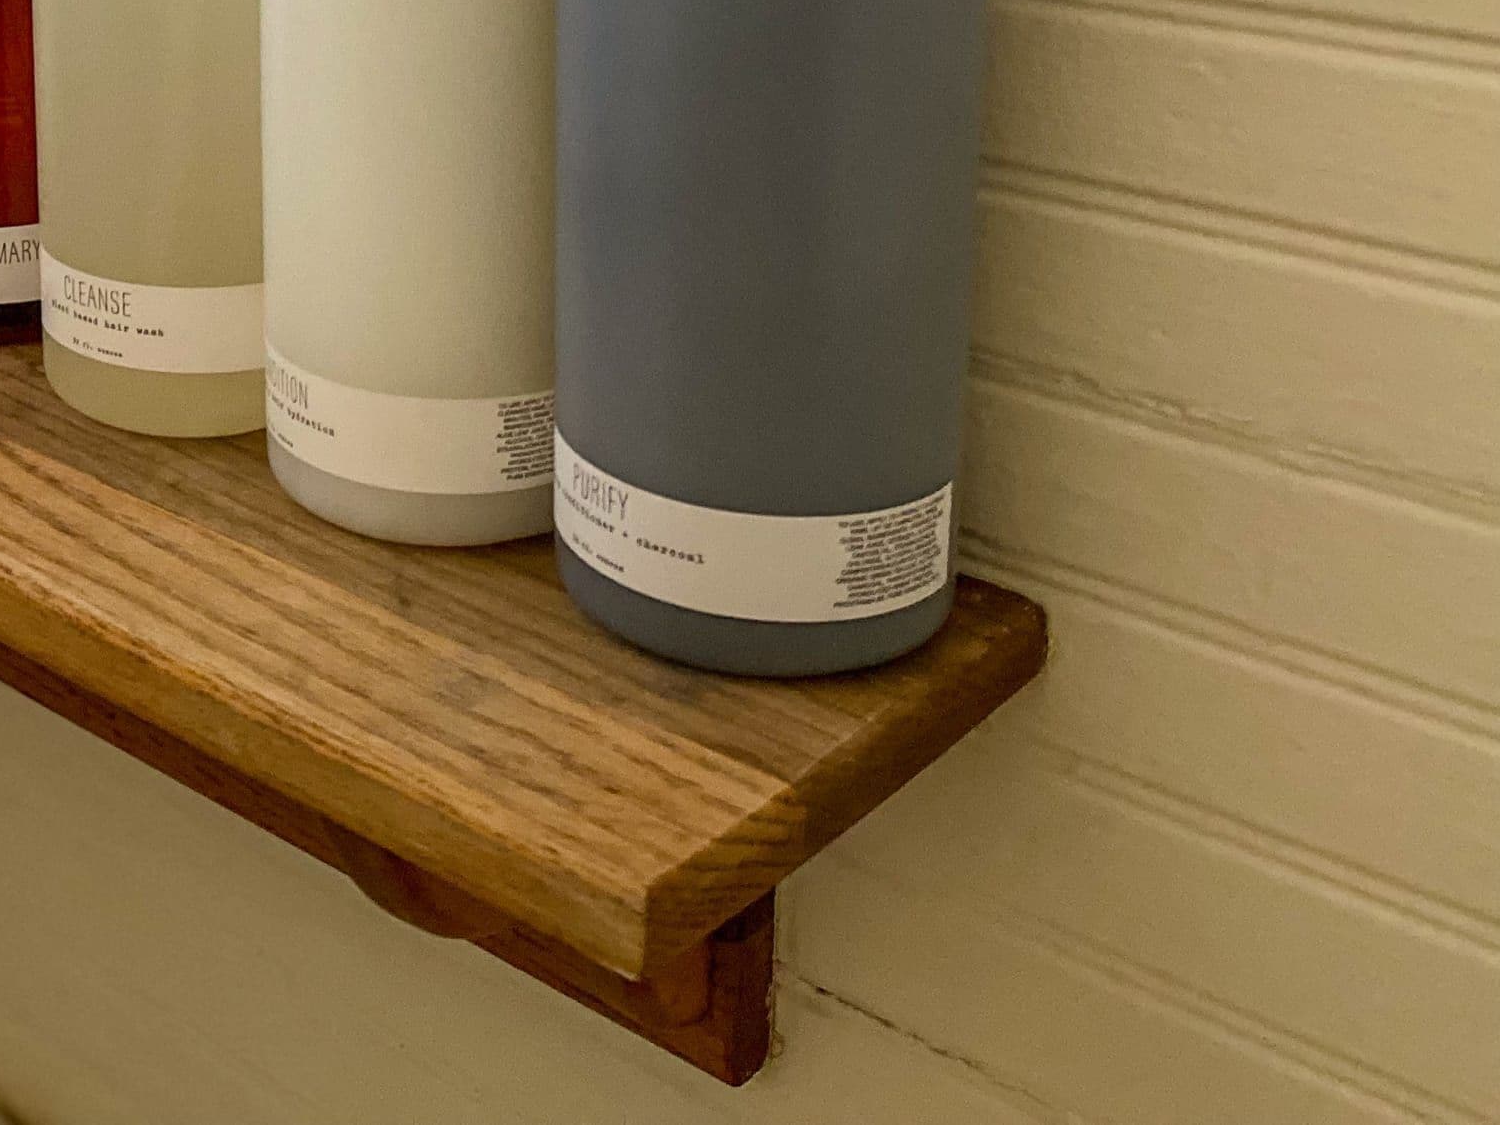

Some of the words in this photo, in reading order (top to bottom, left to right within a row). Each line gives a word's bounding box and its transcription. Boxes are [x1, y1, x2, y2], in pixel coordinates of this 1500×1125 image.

[63, 275, 132, 318] CLEANSE
[73, 310, 98, 326] based
[104, 320, 129, 333] hair
[136, 327, 164, 338] wash
[573, 462, 629, 521] PURIFY
[636, 537, 705, 565] charcoal
